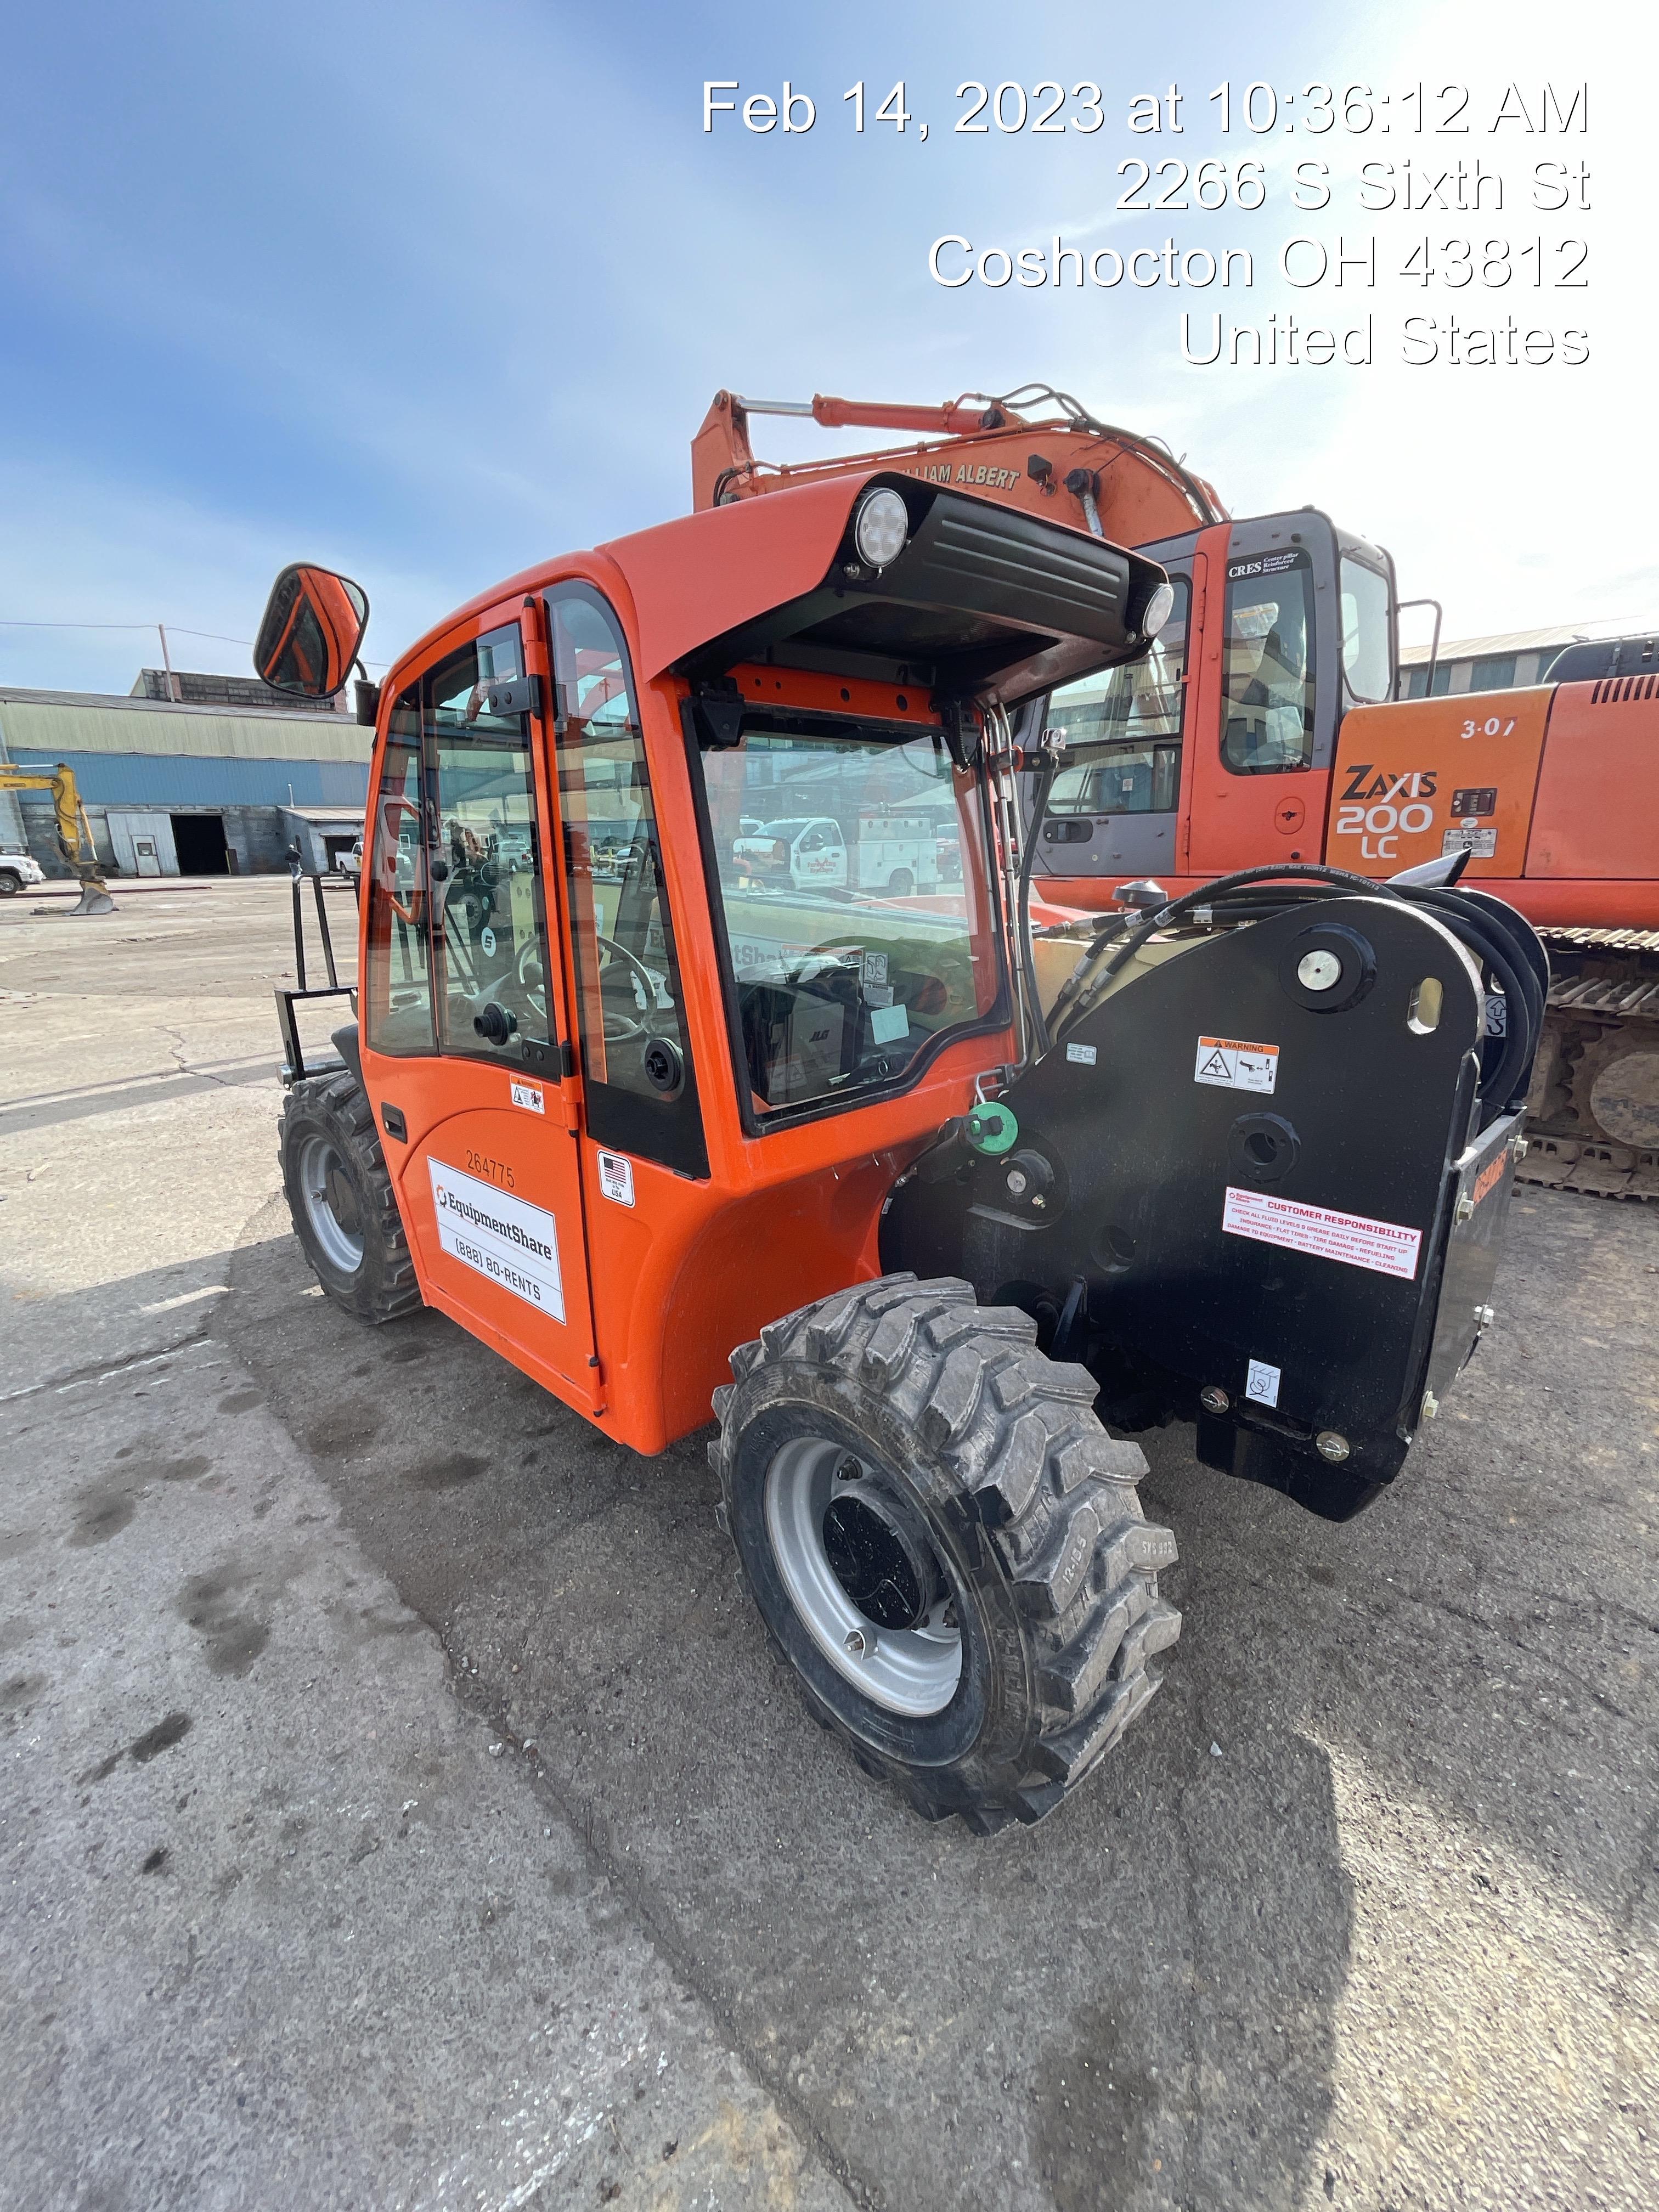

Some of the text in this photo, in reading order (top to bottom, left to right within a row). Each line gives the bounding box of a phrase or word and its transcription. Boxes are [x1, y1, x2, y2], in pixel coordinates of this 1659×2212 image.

[955, 465, 1020, 491] ALBERT
[1228, 561, 1262, 578] CRES
[1262, 565, 1289, 573] Structure
[1263, 558, 1294, 568] Reinforced
[1336, 803, 1434, 834] 200
[1361, 835, 1399, 859] LC
[1224, 1041, 1264, 1053] WARNING
[466, 1149, 515, 1188] 264775
[612, 1188, 622, 1199] USA
[448, 1192, 552, 1260] EquipmentShare
[1232, 1207, 1250, 1216] CHECK
[1261, 1215, 1279, 1223] FLUID
[1279, 1218, 1300, 1228] LEVELS
[1307, 1226, 1330, 1235] GREASE
[1331, 1232, 1350, 1240] DAILY
[1351, 1237, 1375, 1247] BEFORE
[1376, 1243, 1397, 1252] START
[1267, 1201, 1417, 1242] CUSTOMER RESPONSIBILITY
[1227, 1223, 1250, 1233] DAMAGE
[1260, 1231, 1294, 1244] EQUIPMENT
[1297, 1241, 1324, 1251] BATTERY
[1325, 1248, 1370, 1264] MAINTENANCE
[1375, 1261, 1408, 1273] CLEANING
[1240, 1217, 1272, 1230] INSURANCE
[1291, 1230, 1308, 1239] TIRES
[1313, 1236, 1328, 1244] TIRE
[1328, 1240, 1355, 1251] DAMAGE
[1359, 1248, 1396, 1261] REFUELING
[455, 1238, 541, 1301] (888) 80-RENTS
